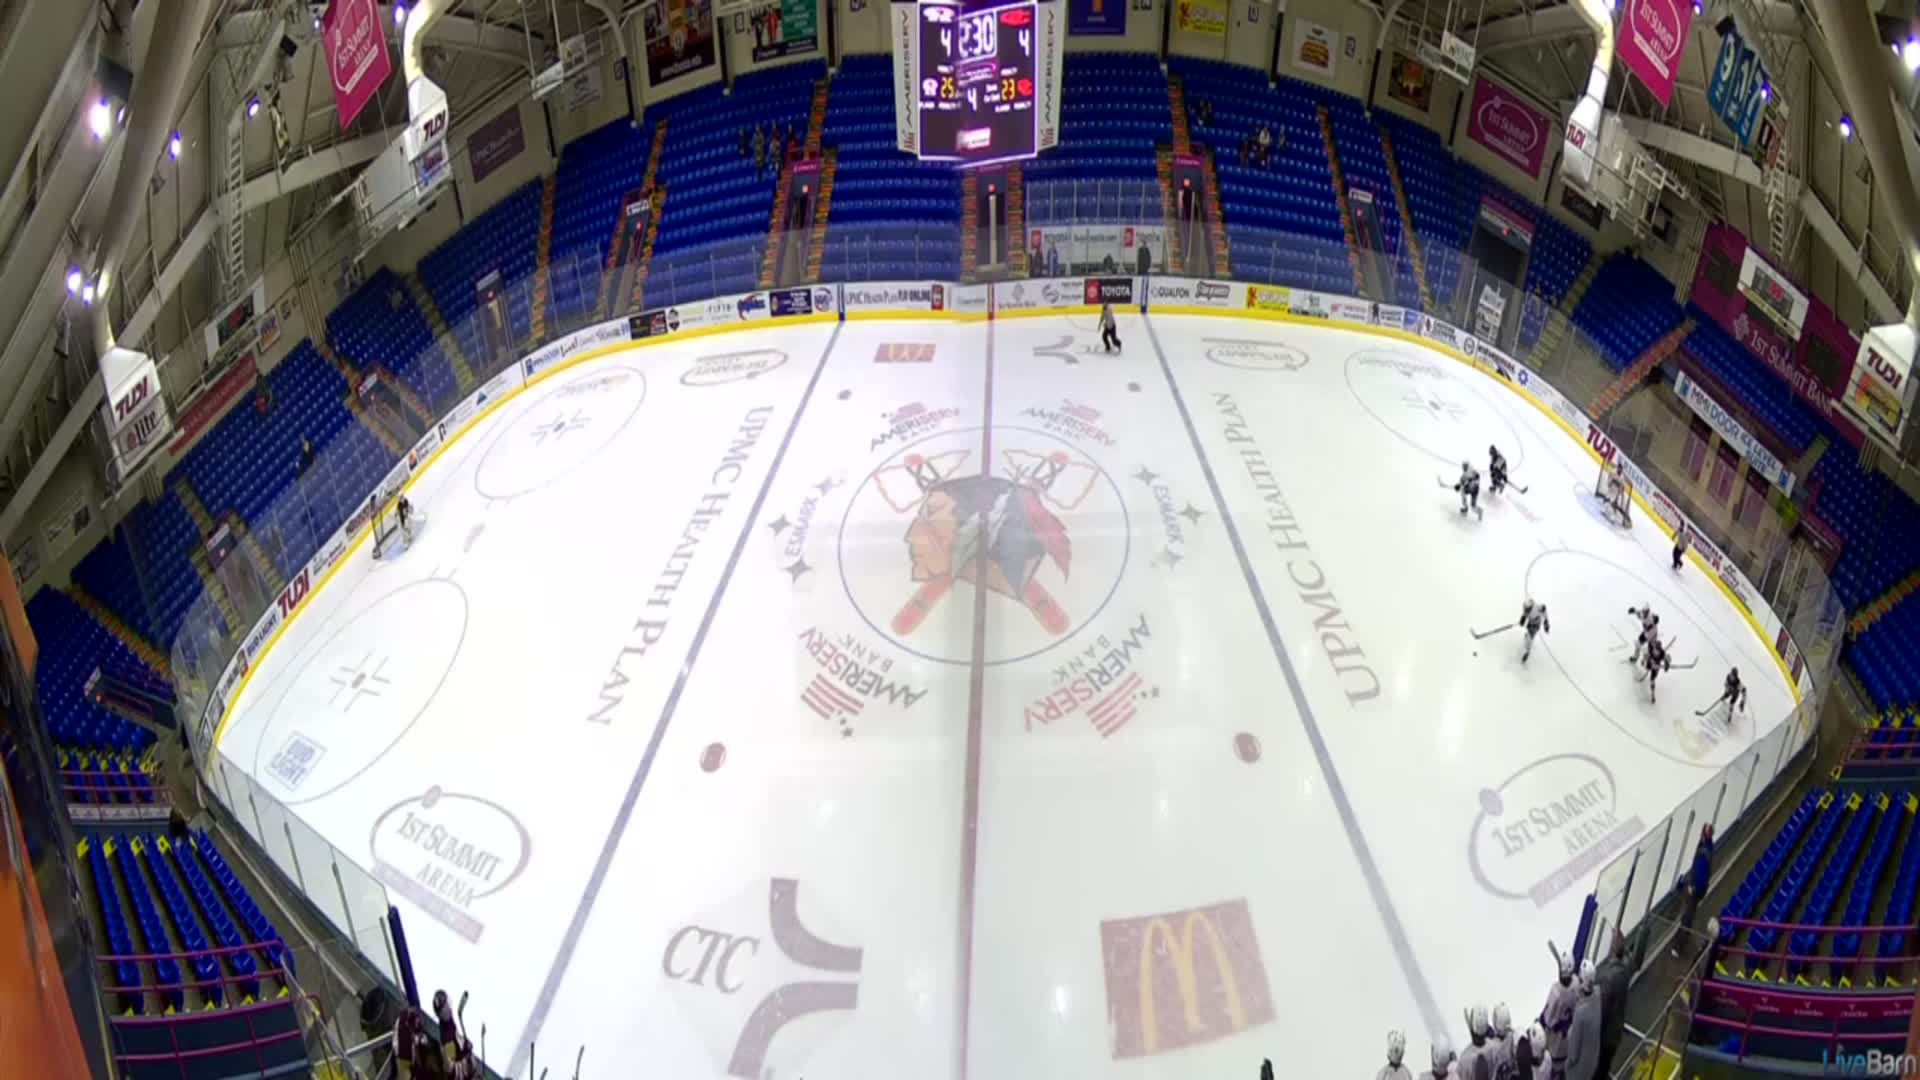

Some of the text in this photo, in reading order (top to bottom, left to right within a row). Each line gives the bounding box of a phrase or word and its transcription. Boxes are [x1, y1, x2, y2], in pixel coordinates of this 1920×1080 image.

[940, 27, 951, 57] 4
[1018, 28, 1030, 57] 4
[967, 87, 977, 111] 4
[423, 109, 446, 141] TUDI
[1566, 123, 1586, 150] TUDI
[1101, 285, 1131, 297] TOYOTA
[1751, 330, 1768, 355] 1ST
[1866, 345, 1903, 390] TUDI
[114, 375, 148, 421] TUDI
[1211, 391, 1256, 445] PLAN
[1710, 404, 1741, 439] DOOR
[712, 404, 775, 485] UPMC
[1586, 424, 1617, 461] TUDI
[1153, 482, 1185, 545] ESMARK
[1239, 448, 1311, 551] HEALTH
[645, 492, 732, 608] HEALTH
[783, 496, 819, 557] ESMARK
[277, 567, 311, 620] TUDI
[839, 633, 894, 674] BANK
[1286, 558, 1381, 709] UPMC
[586, 615, 669, 727] PLAN
[798, 626, 928, 709] AMERISERV
[1023, 612, 1152, 733] AMERISERV
[1053, 634, 1111, 684] BANK
[1491, 778, 1606, 859] 1ST SUMMIT
[1563, 809, 1618, 856] ARENA
[422, 824, 504, 881] SUMMIT
[416, 860, 476, 909] ARENA
[661, 924, 761, 995] CTC
